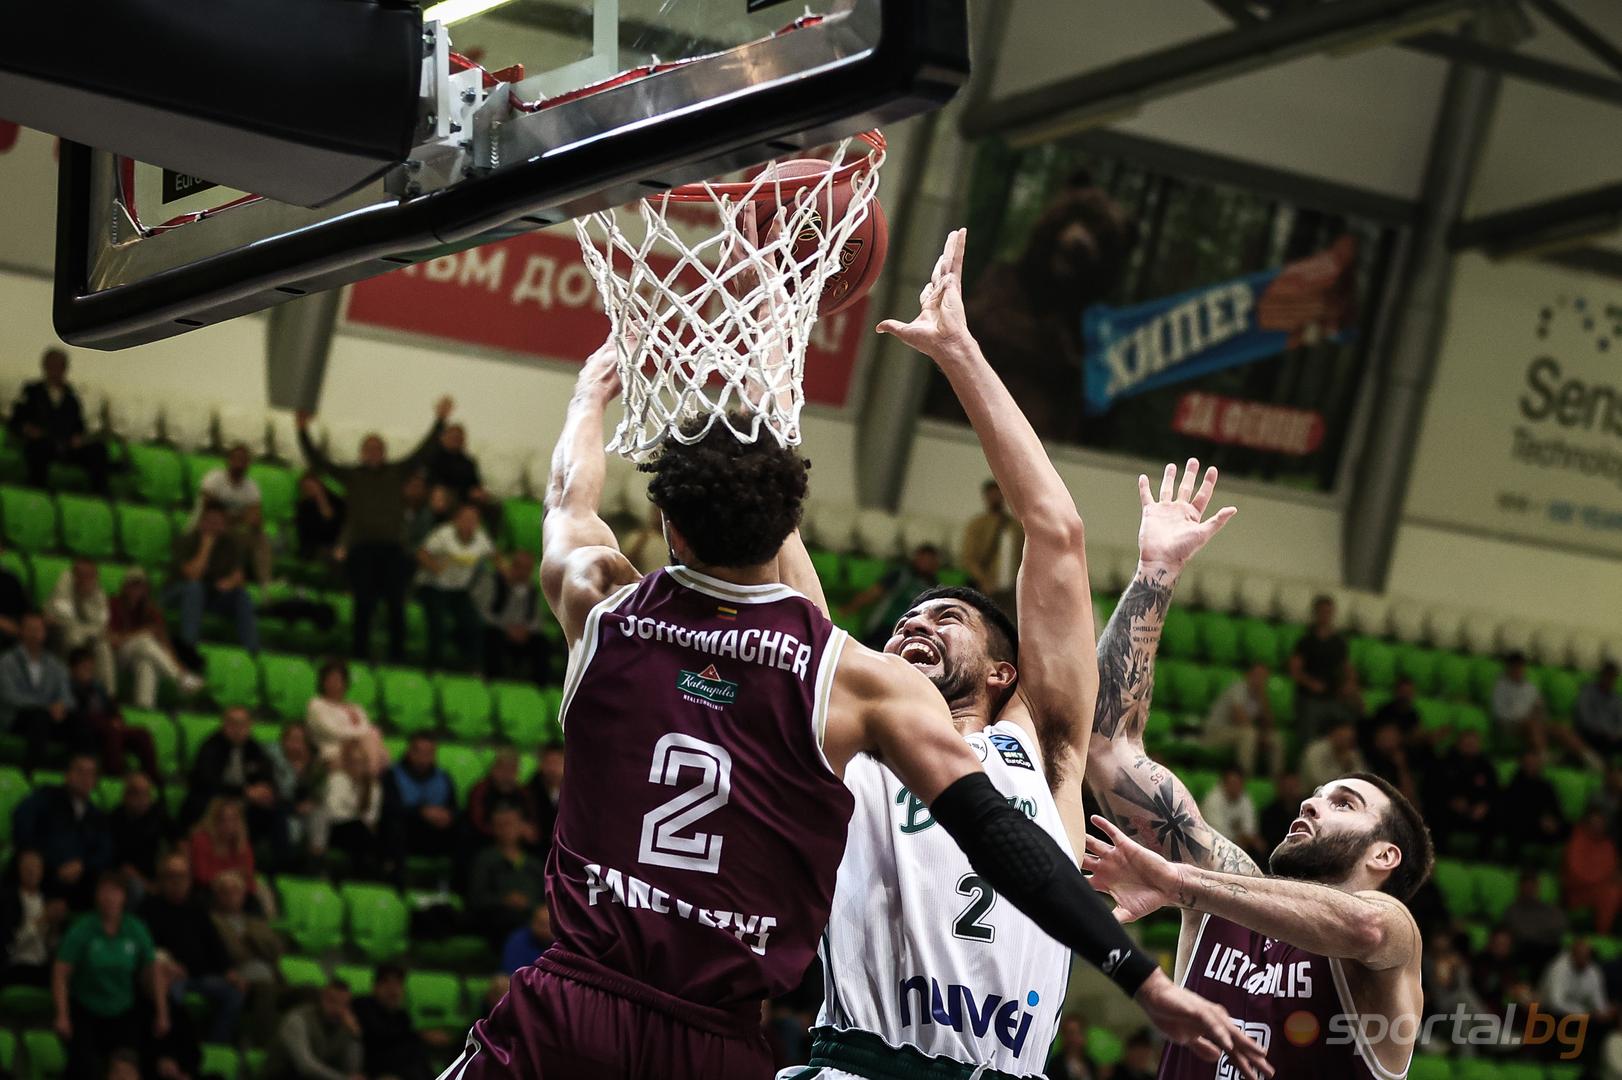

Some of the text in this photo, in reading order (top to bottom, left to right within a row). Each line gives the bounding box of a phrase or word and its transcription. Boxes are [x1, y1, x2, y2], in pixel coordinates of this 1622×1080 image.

[680, 673, 736, 699] Kalnapilis
[638, 732, 732, 874] 2
[952, 872, 998, 944] 2
[899, 975, 1040, 1059] nuvei
